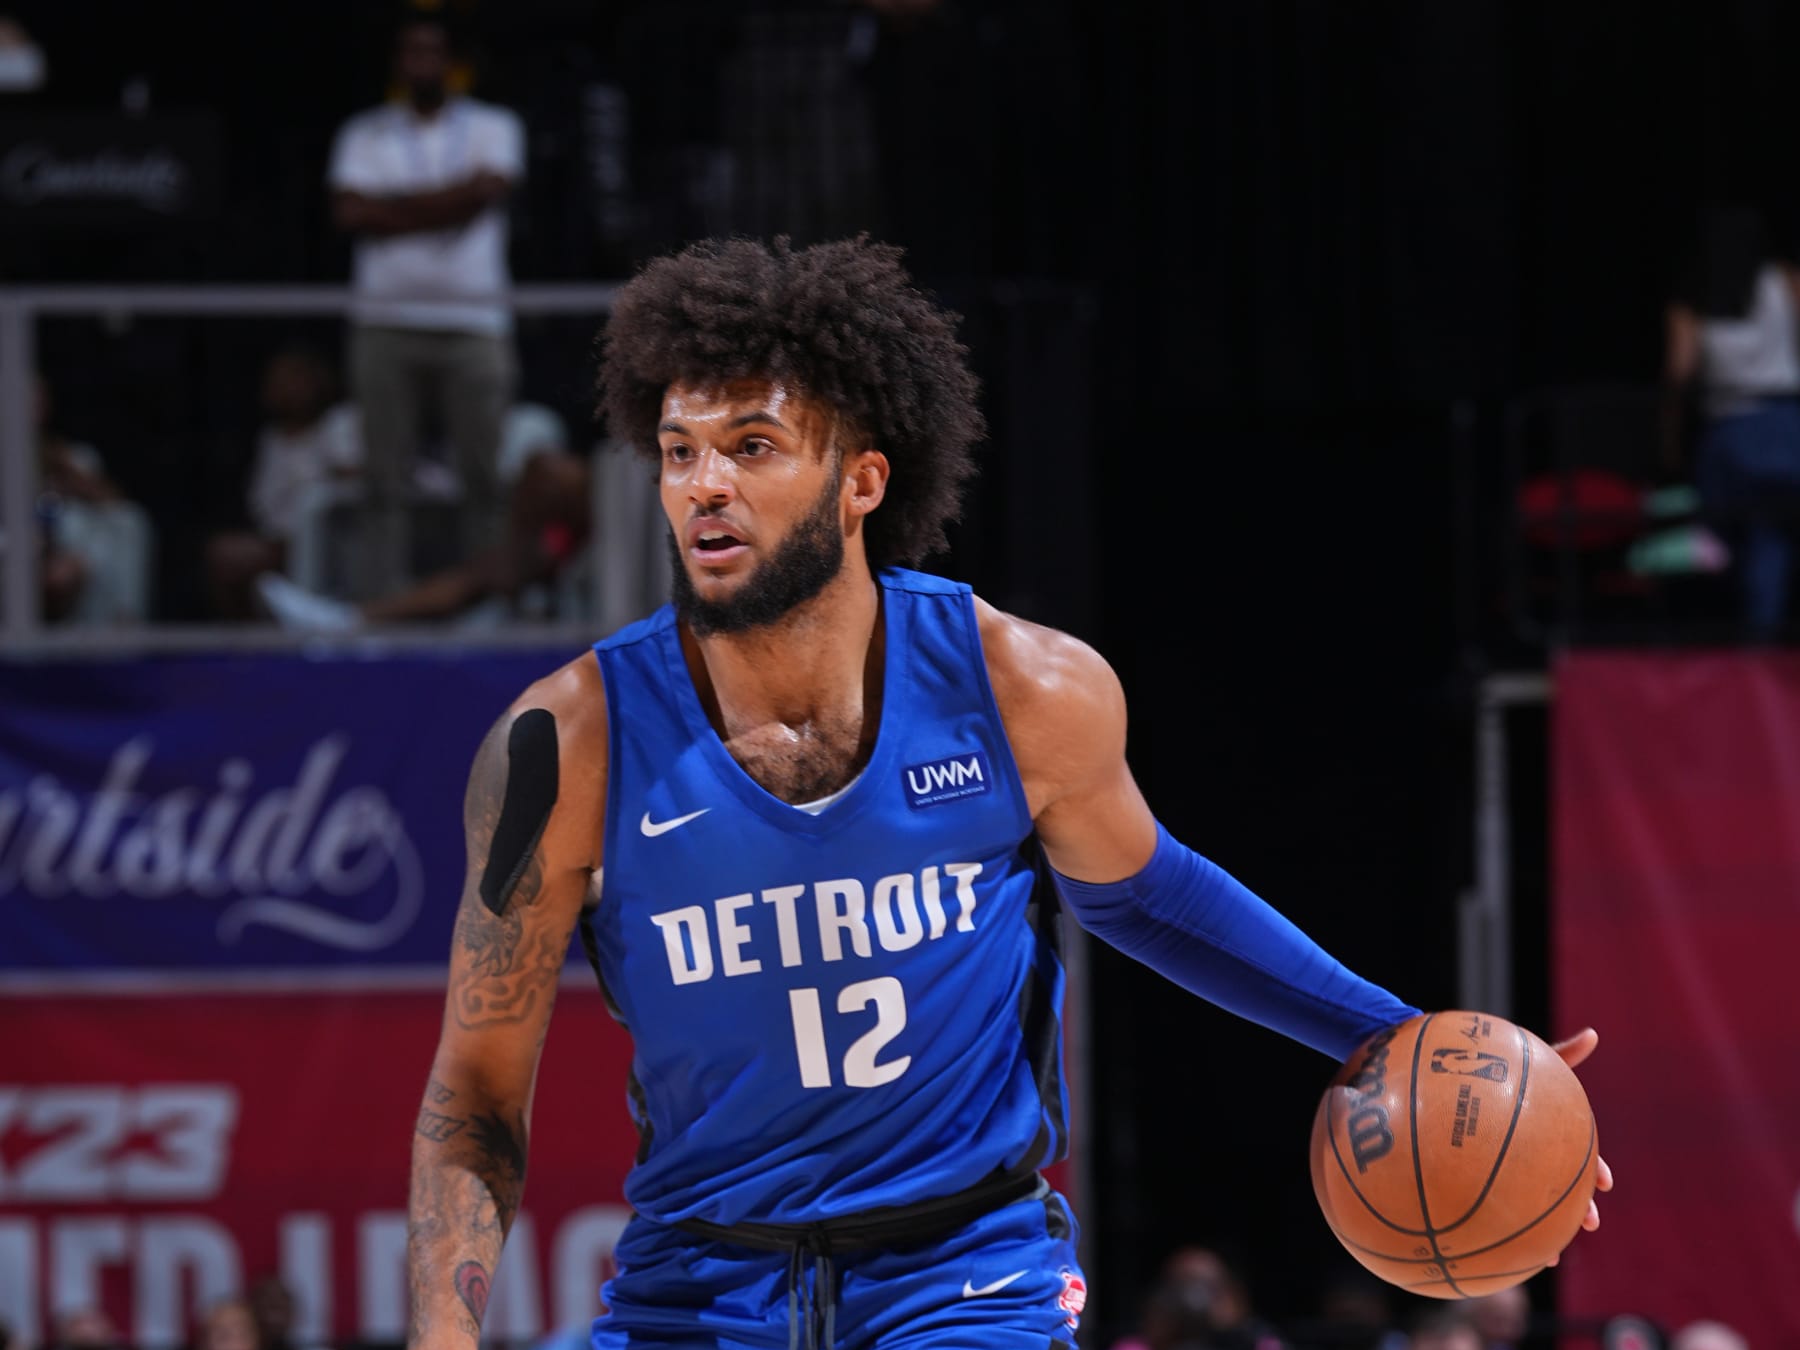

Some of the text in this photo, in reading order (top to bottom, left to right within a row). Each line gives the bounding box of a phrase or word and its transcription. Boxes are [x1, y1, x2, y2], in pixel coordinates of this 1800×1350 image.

[907, 757, 984, 795] UWM
[650, 862, 983, 986] DETROIT
[788, 976, 912, 1089] 12
